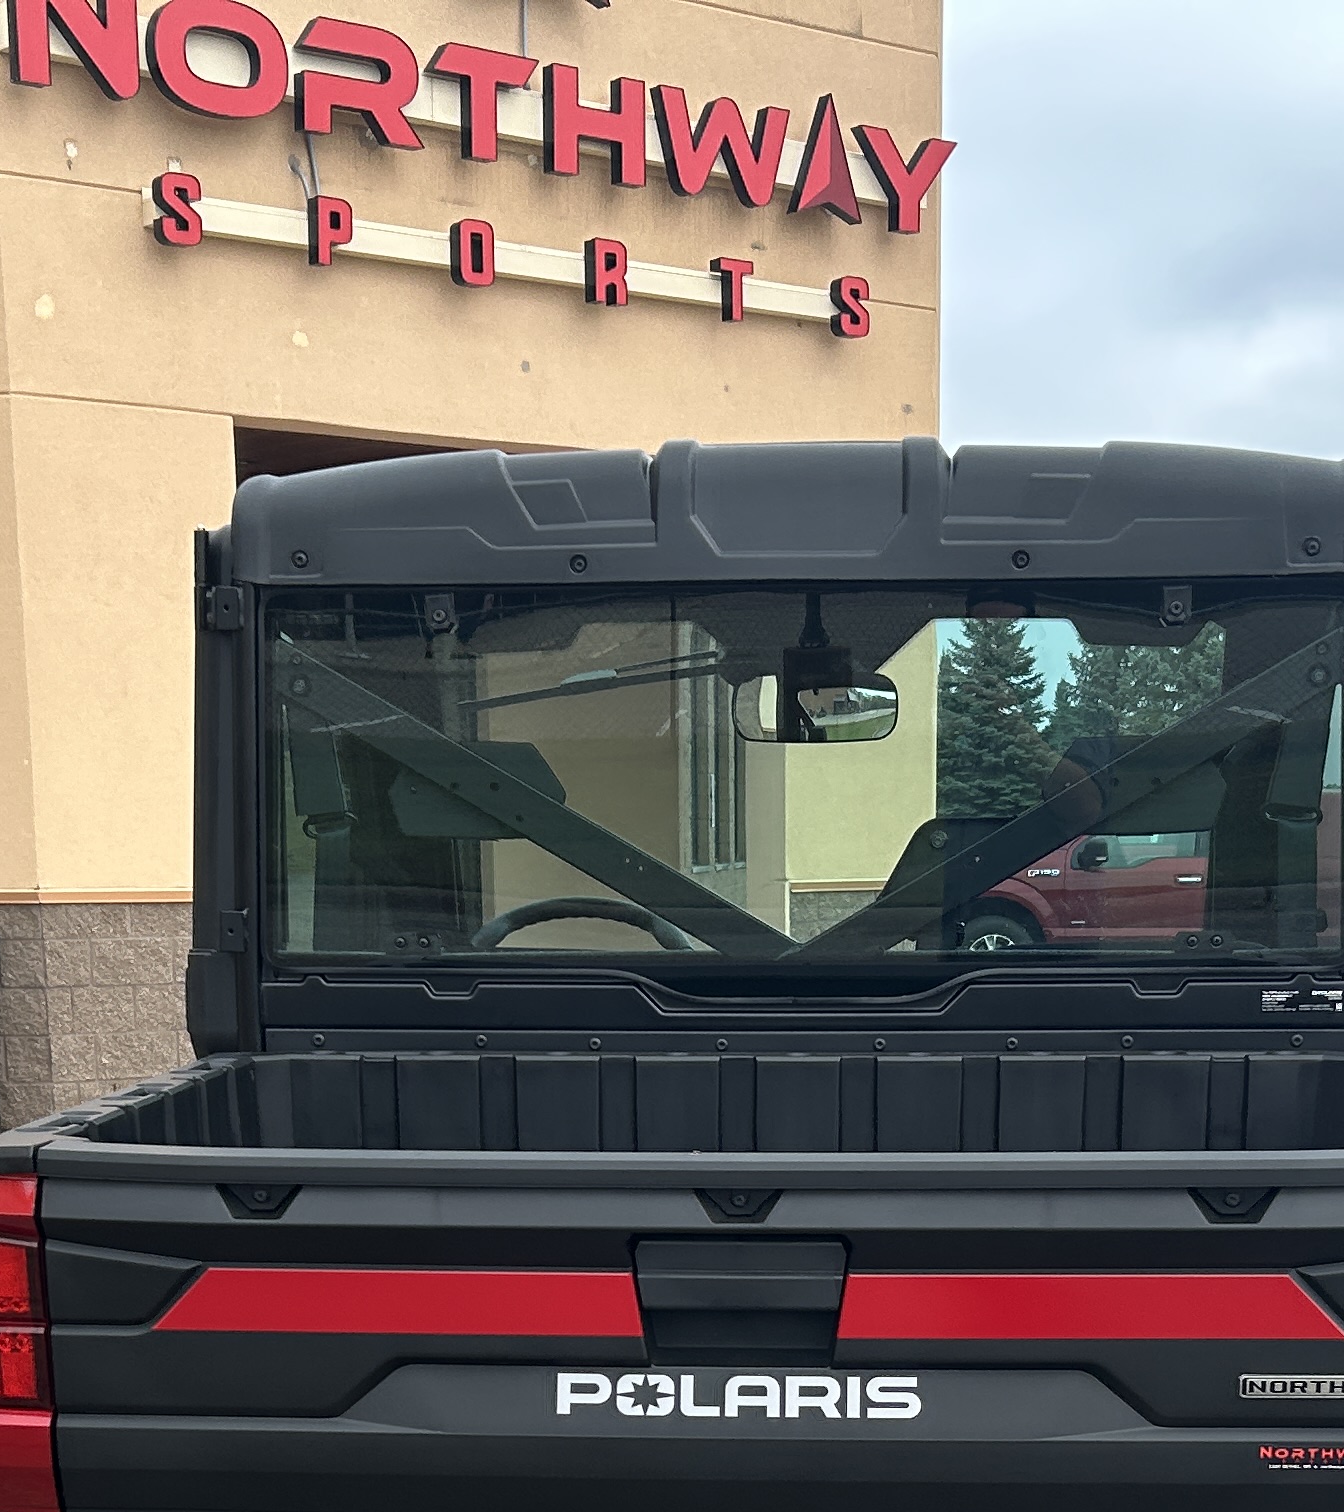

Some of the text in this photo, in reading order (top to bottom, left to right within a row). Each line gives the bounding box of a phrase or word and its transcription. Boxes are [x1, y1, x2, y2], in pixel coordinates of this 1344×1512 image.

[7, 0, 957, 234] NORTHWAY
[153, 172, 870, 338] SPORTS
[556, 1372, 922, 1419] POLARIS
